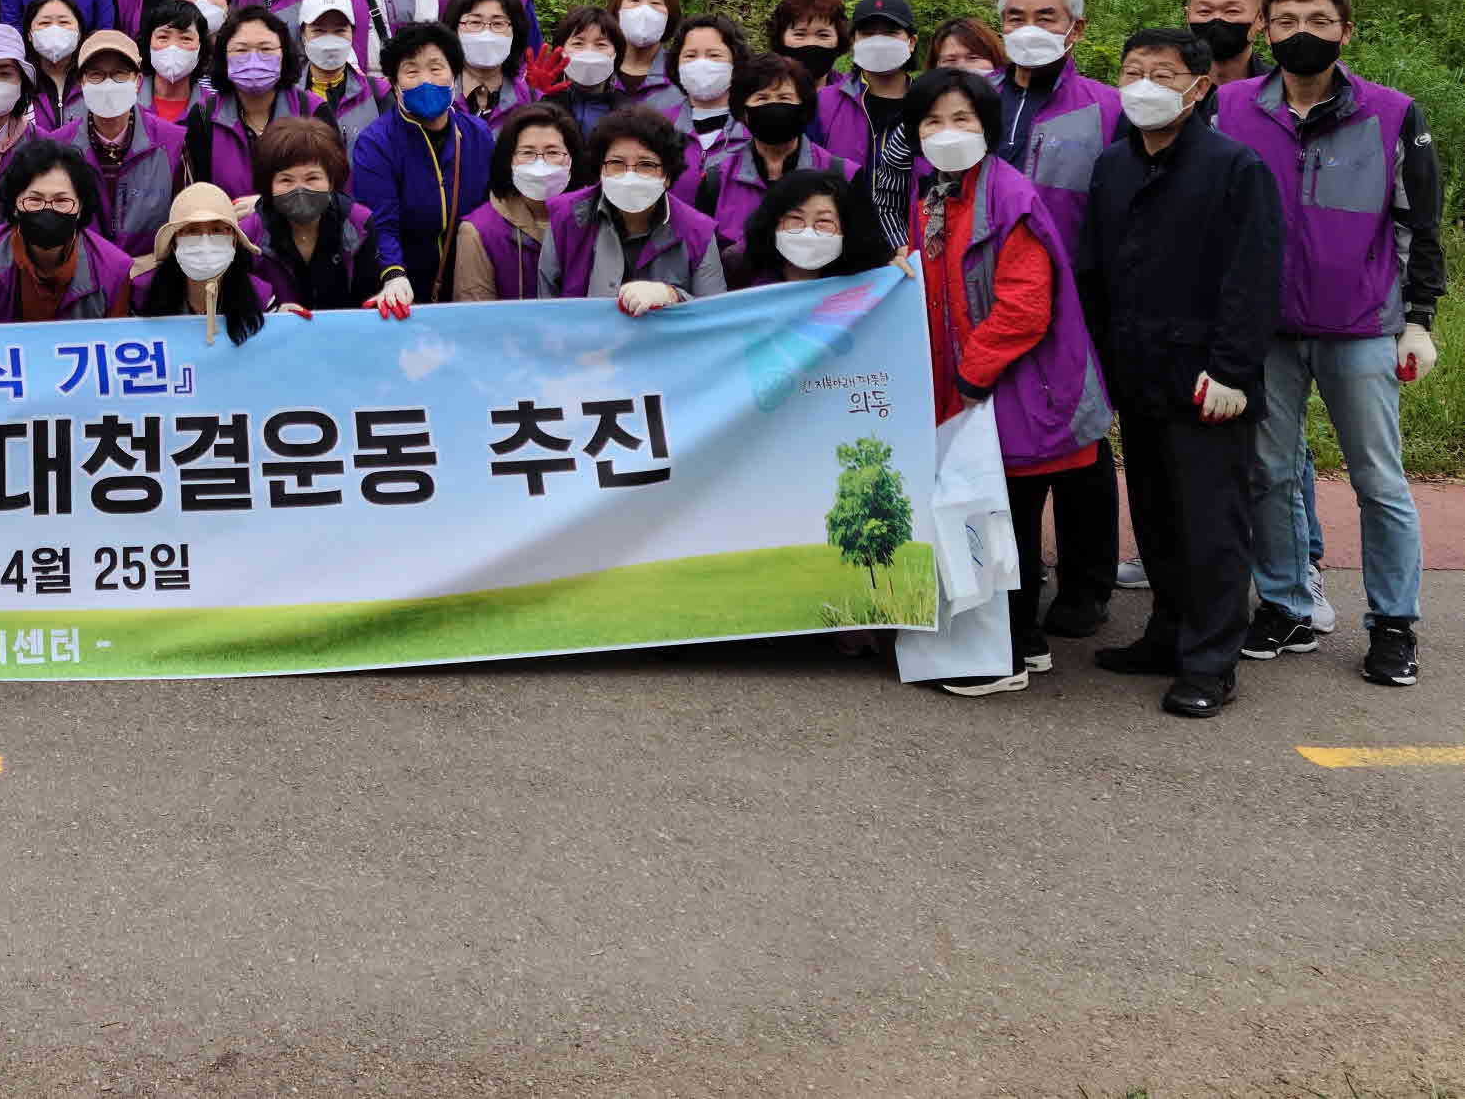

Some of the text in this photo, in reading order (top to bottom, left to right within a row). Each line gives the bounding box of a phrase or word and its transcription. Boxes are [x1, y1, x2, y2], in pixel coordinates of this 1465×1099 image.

[488, 394, 672, 497] 추진
[0, 546, 72, 595] 4월
[93, 543, 192, 592] 25일
